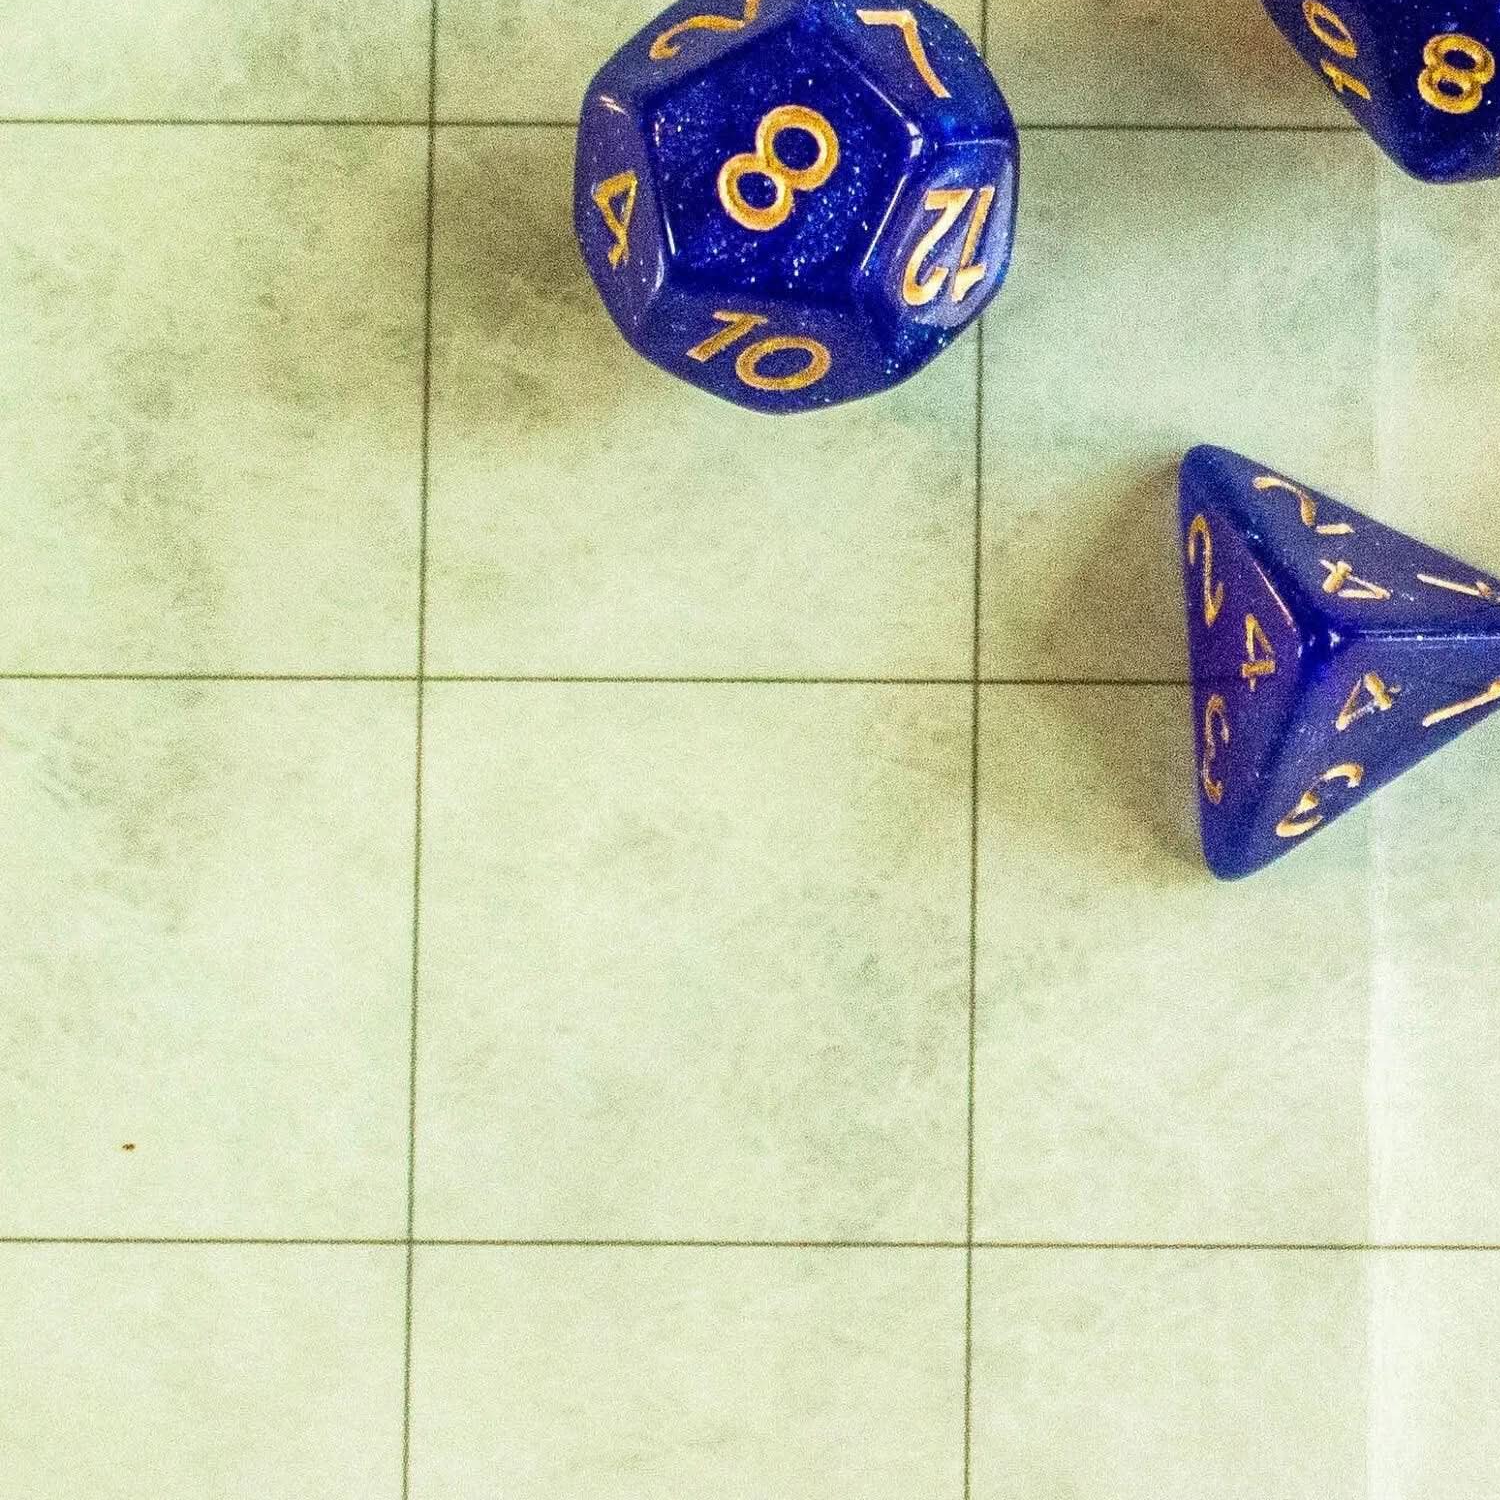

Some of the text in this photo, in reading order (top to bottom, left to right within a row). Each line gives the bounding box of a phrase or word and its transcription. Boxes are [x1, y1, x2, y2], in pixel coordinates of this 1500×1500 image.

[856, 8, 952, 99] 7
[1417, 33, 1497, 115] 8
[717, 104, 841, 232] 8
[592, 170, 639, 268] 4
[902, 186, 995, 306] 12
[686, 310, 832, 392] 10
[1253, 476, 1354, 537] 2
[1188, 514, 1224, 628] 2
[1320, 559, 1392, 601] 4
[1242, 613, 1277, 691] 4
[1335, 671, 1402, 731] 4
[1202, 694, 1230, 805] 3
[1276, 762, 1363, 838] 3
